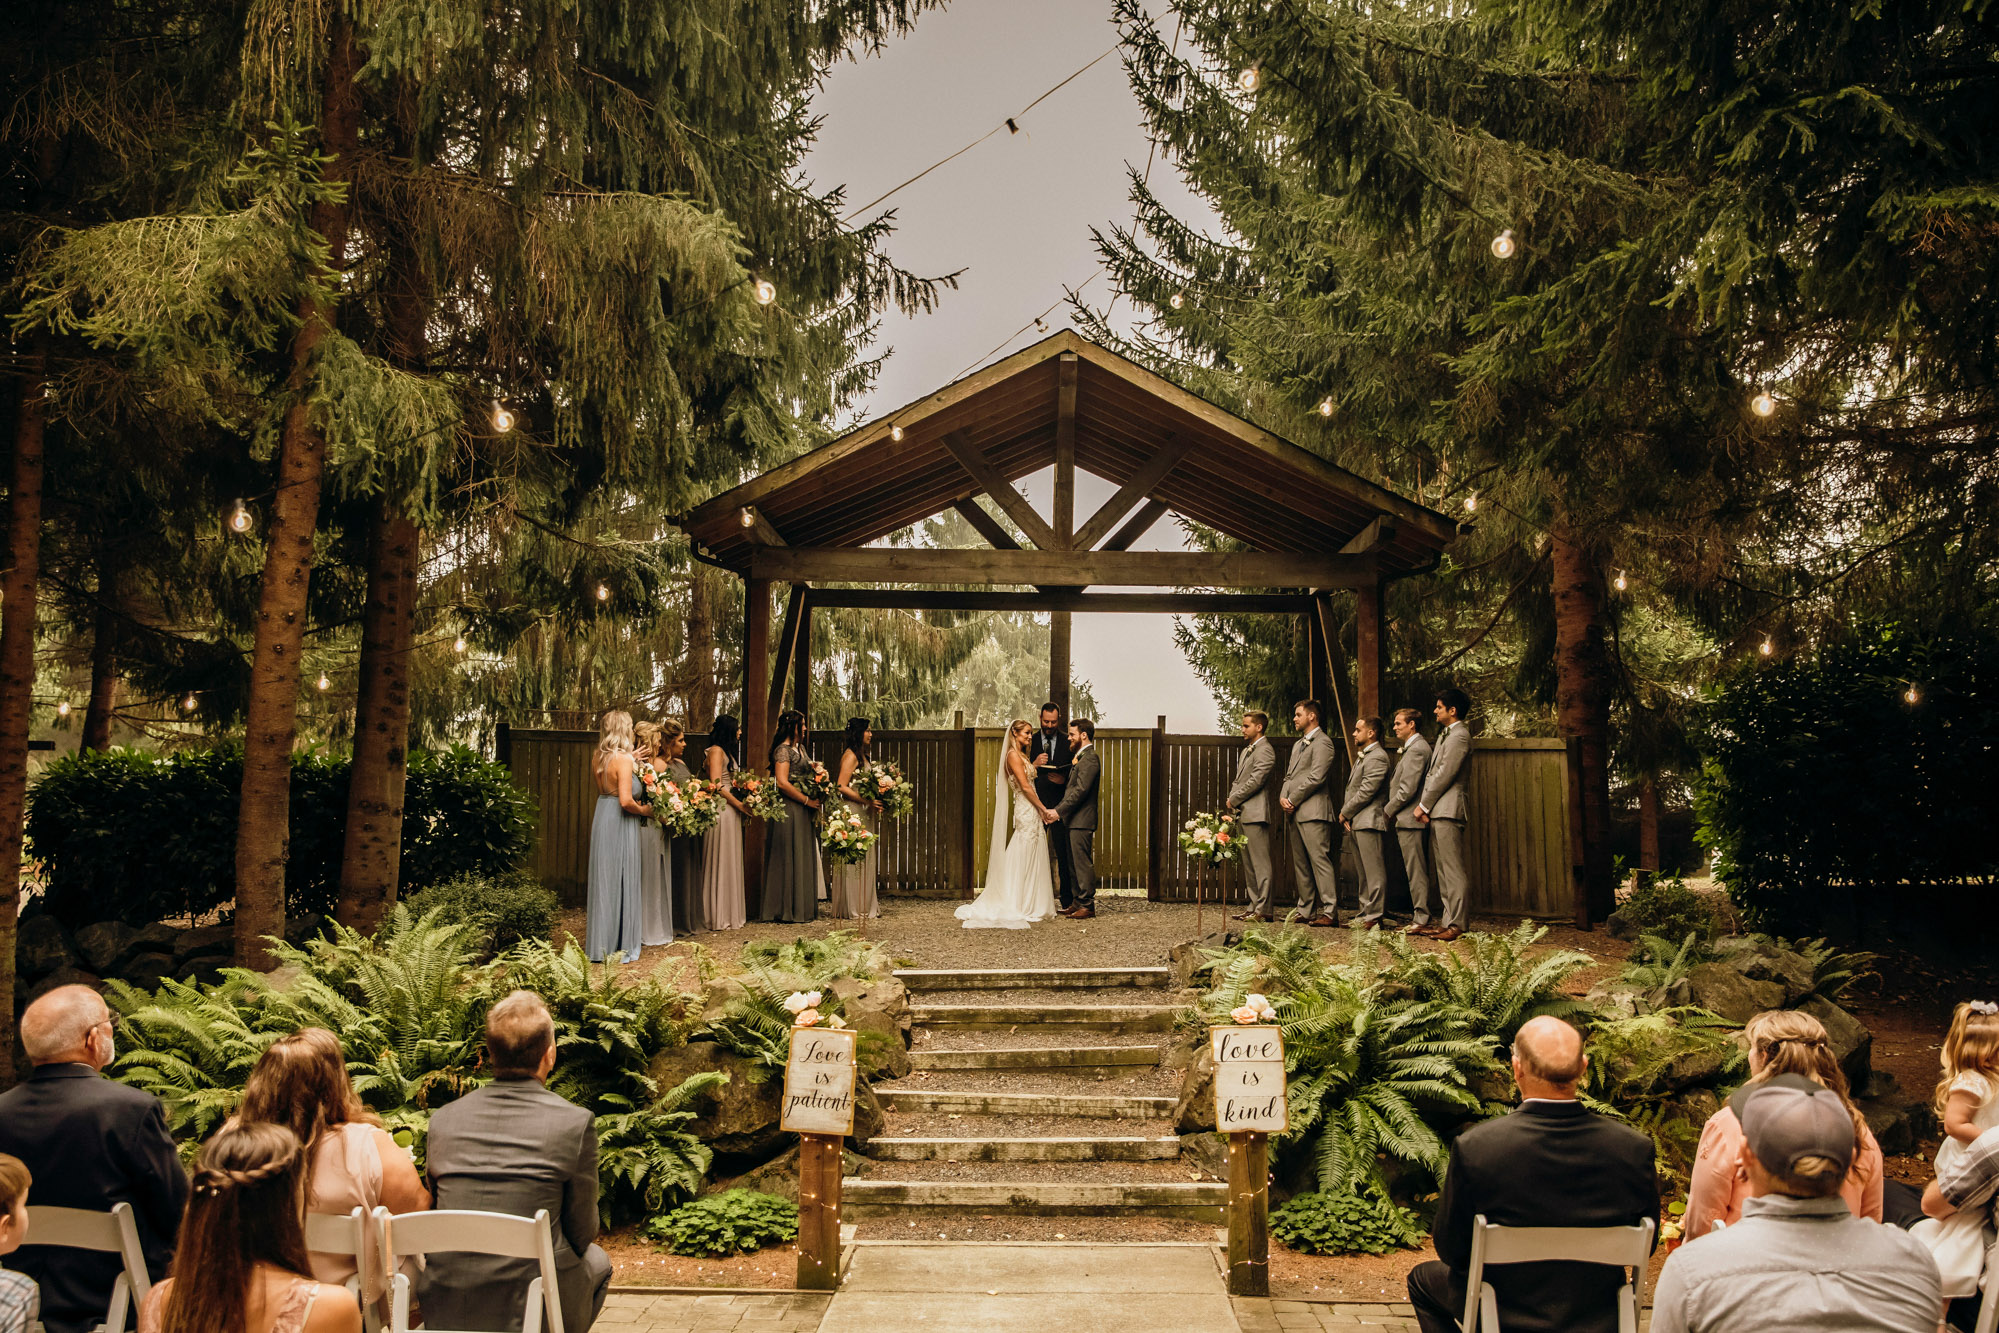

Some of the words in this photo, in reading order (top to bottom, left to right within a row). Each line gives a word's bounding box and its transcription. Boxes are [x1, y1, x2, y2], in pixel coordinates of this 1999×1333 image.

[800, 1041, 847, 1063] Love
[815, 1072, 832, 1084] is
[1242, 1071, 1262, 1086] is
[784, 1090, 851, 1118] patient
[1224, 1096, 1278, 1122] kind
